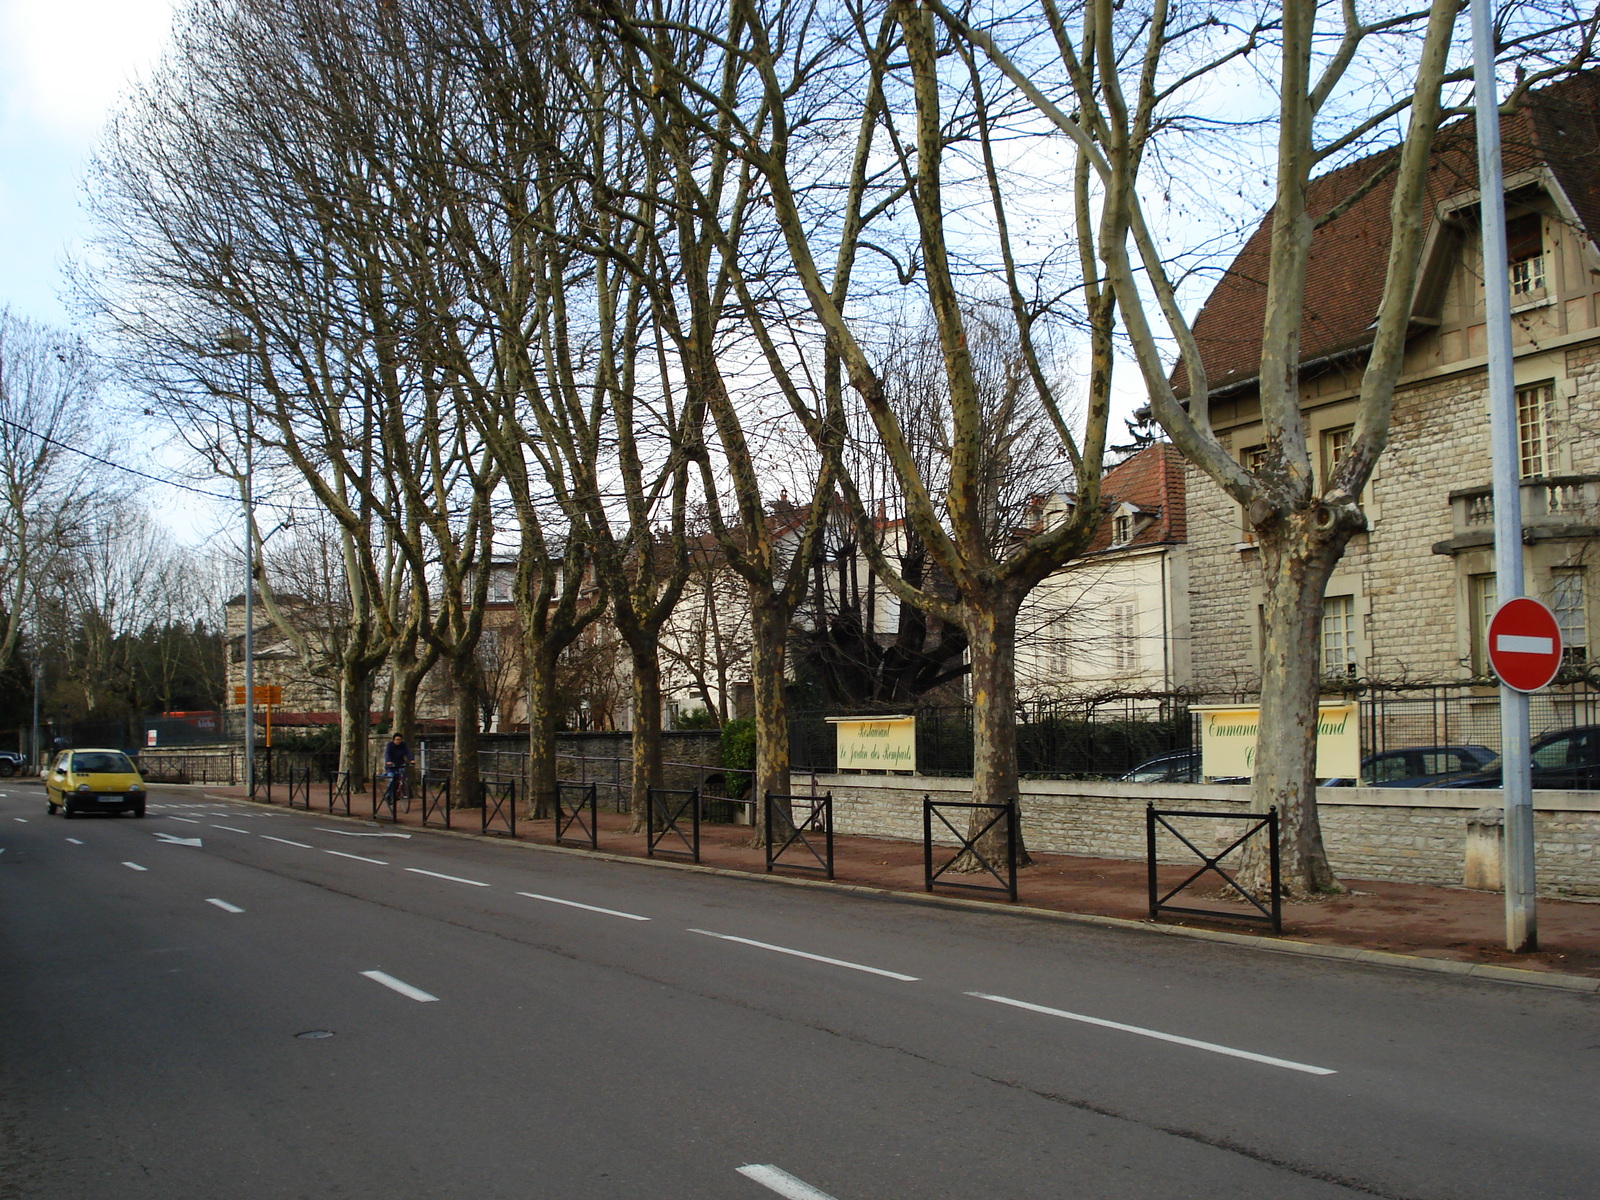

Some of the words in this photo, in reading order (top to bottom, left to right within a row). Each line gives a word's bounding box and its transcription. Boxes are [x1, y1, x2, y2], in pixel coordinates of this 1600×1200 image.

[1208, 714, 1258, 737] Emmanu
[1316, 712, 1349, 735] land
[870, 744, 880, 760] des
